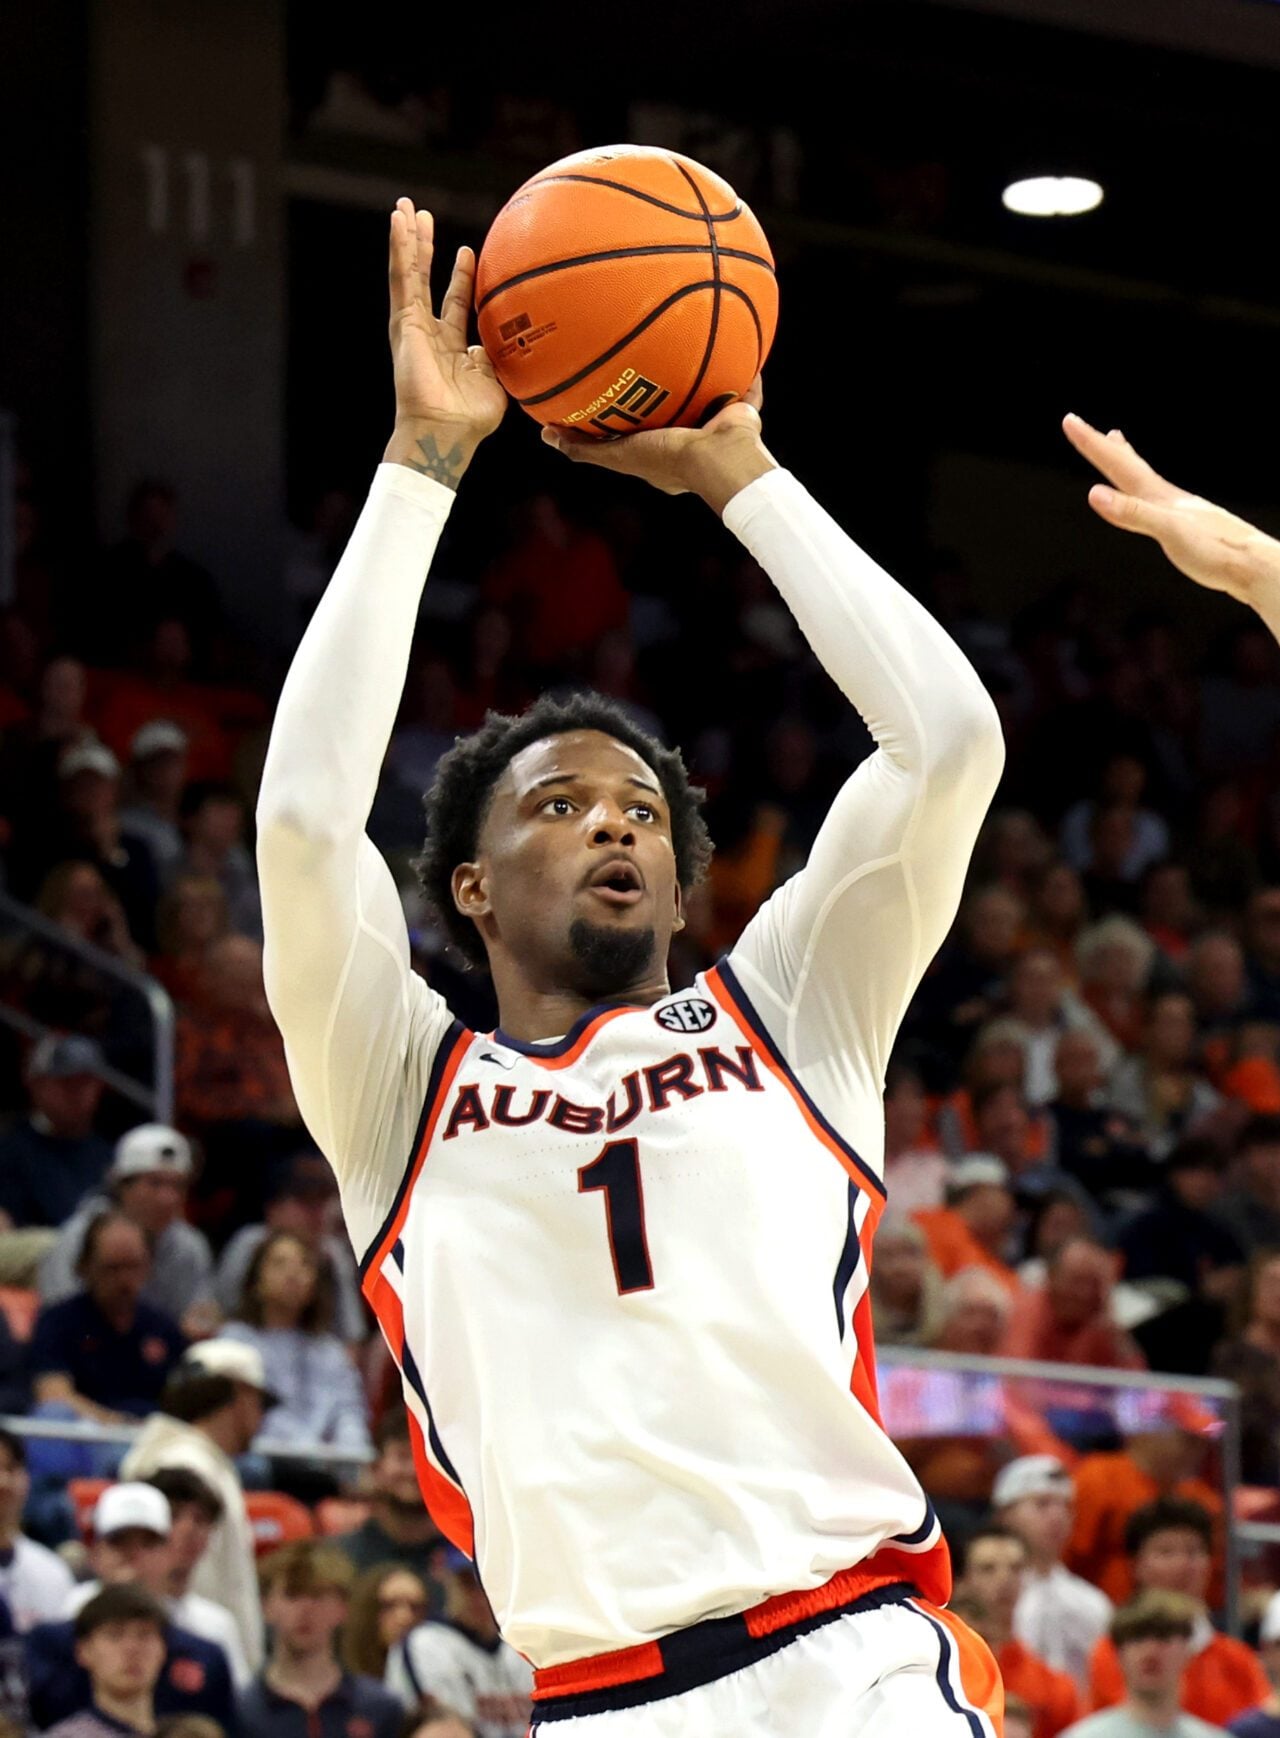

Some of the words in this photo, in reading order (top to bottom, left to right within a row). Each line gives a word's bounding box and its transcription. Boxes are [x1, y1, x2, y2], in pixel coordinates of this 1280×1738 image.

[141, 144, 256, 245] 111
[656, 999, 716, 1032] SEC
[443, 1046, 765, 1140] AUBURN
[577, 1137, 654, 1296] 1
